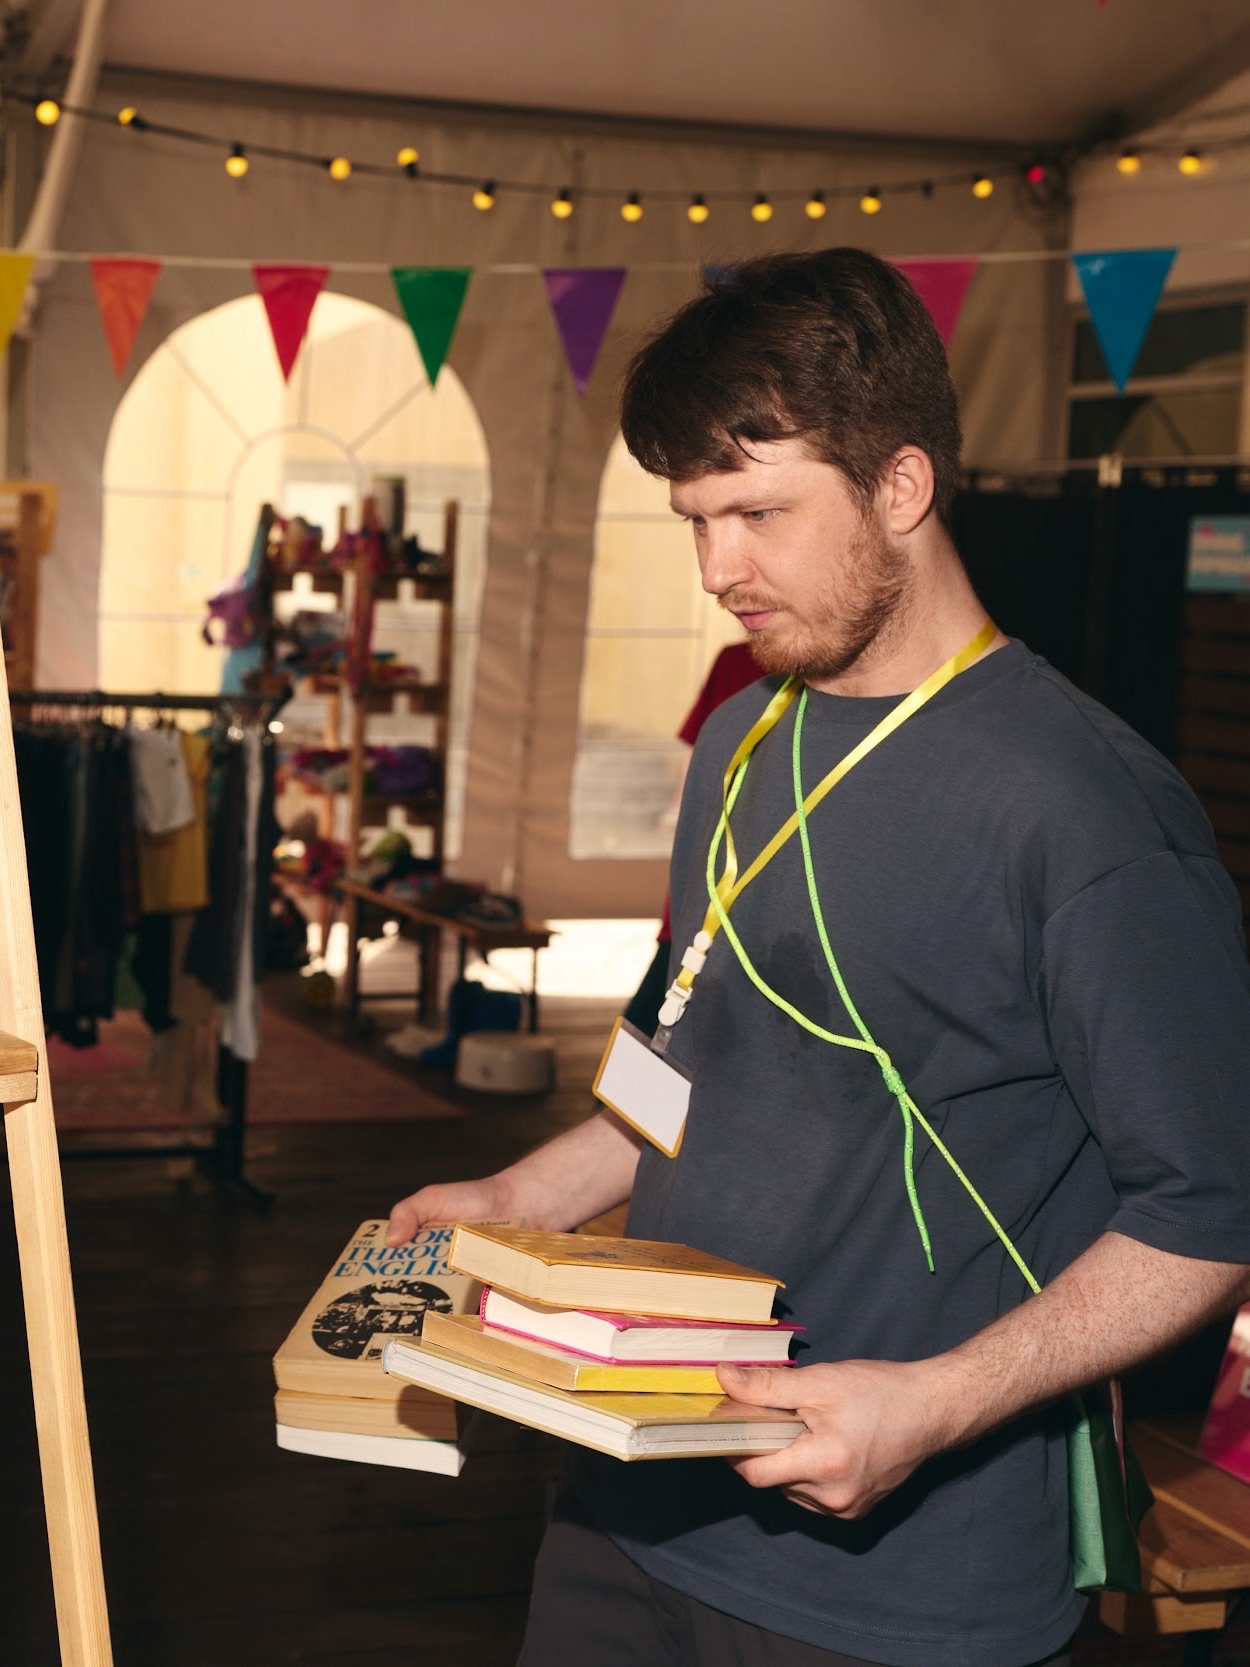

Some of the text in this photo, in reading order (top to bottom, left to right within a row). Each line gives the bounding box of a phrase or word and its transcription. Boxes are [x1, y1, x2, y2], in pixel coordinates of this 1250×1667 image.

[363, 1223, 381, 1239] 2
[347, 1246, 449, 1262] THROU
[334, 1260, 457, 1278] ENGLIS
